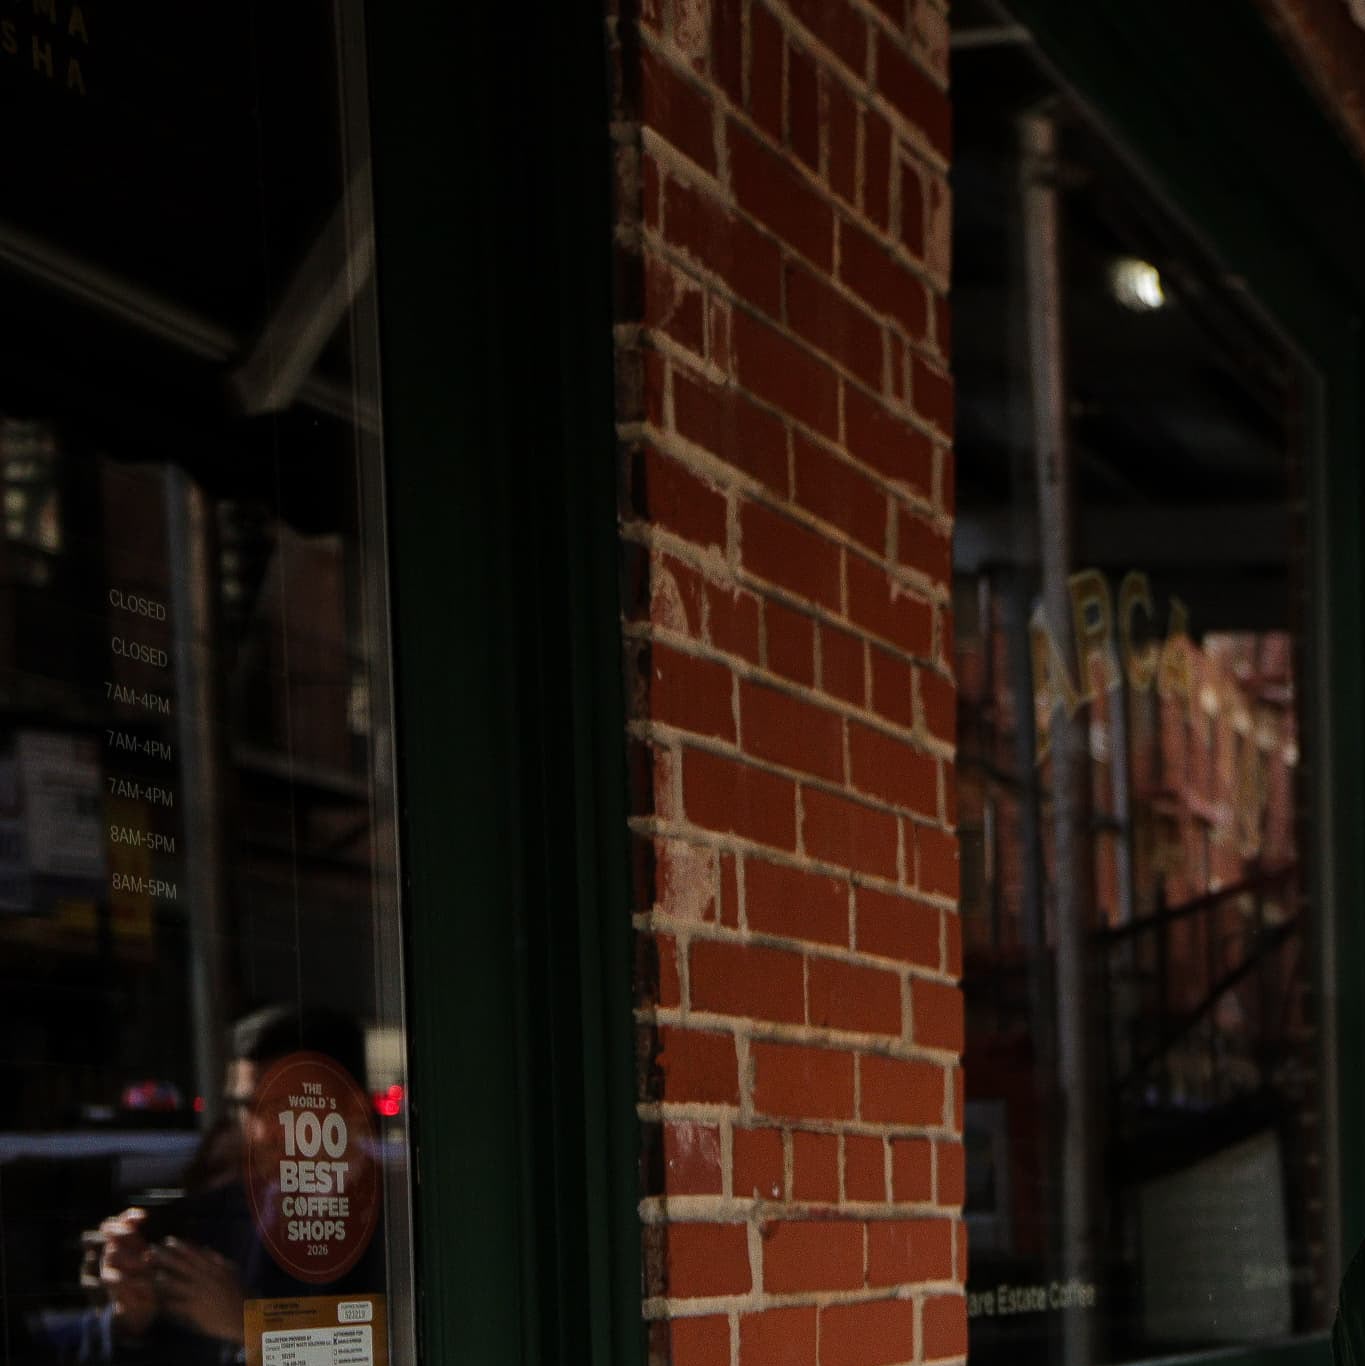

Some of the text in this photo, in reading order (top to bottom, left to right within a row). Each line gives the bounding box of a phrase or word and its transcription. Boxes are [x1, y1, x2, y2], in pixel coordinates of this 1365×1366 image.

[109, 589, 166, 620] CLOSED
[111, 637, 168, 668] CLOSED
[104, 682, 170, 714] 7AM-4PM
[105, 729, 171, 760] 7AM-4PM
[108, 778, 173, 808] 7AM-4PM
[110, 825, 175, 854] 8AM-5PM
[112, 872, 177, 900] 8AM-5PM
[302, 1082, 322, 1095] THE
[278, 1110, 348, 1159] 100
[280, 1160, 349, 1194] BEST
[281, 1196, 350, 1218] COFFEE
[287, 1220, 346, 1242] SHOPS
[307, 1244, 329, 1256] 2026
[997, 1284, 1046, 1315] Estate
[1049, 1277, 1096, 1310] Coffee
